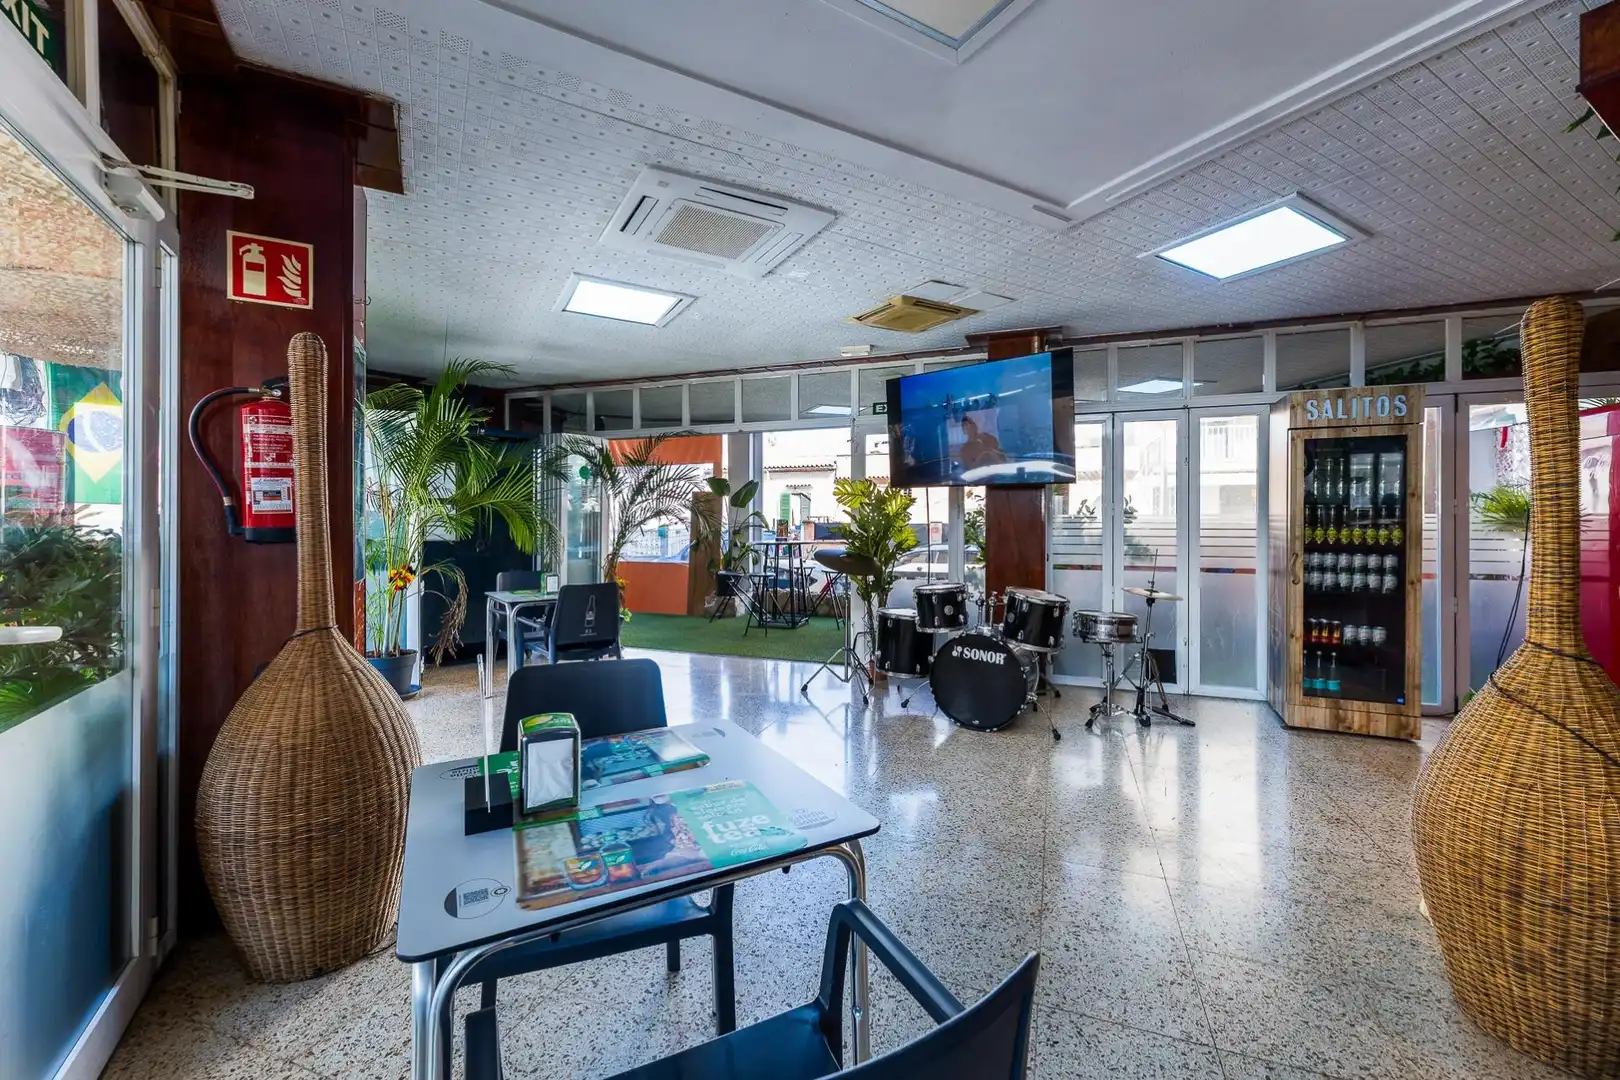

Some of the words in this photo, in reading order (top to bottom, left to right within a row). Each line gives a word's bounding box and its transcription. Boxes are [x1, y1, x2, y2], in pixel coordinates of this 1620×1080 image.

[1306, 395, 1407, 420] SALITOS
[963, 647, 1005, 664] SONOR
[702, 814, 770, 834] fuze
[708, 826, 760, 844] tea
